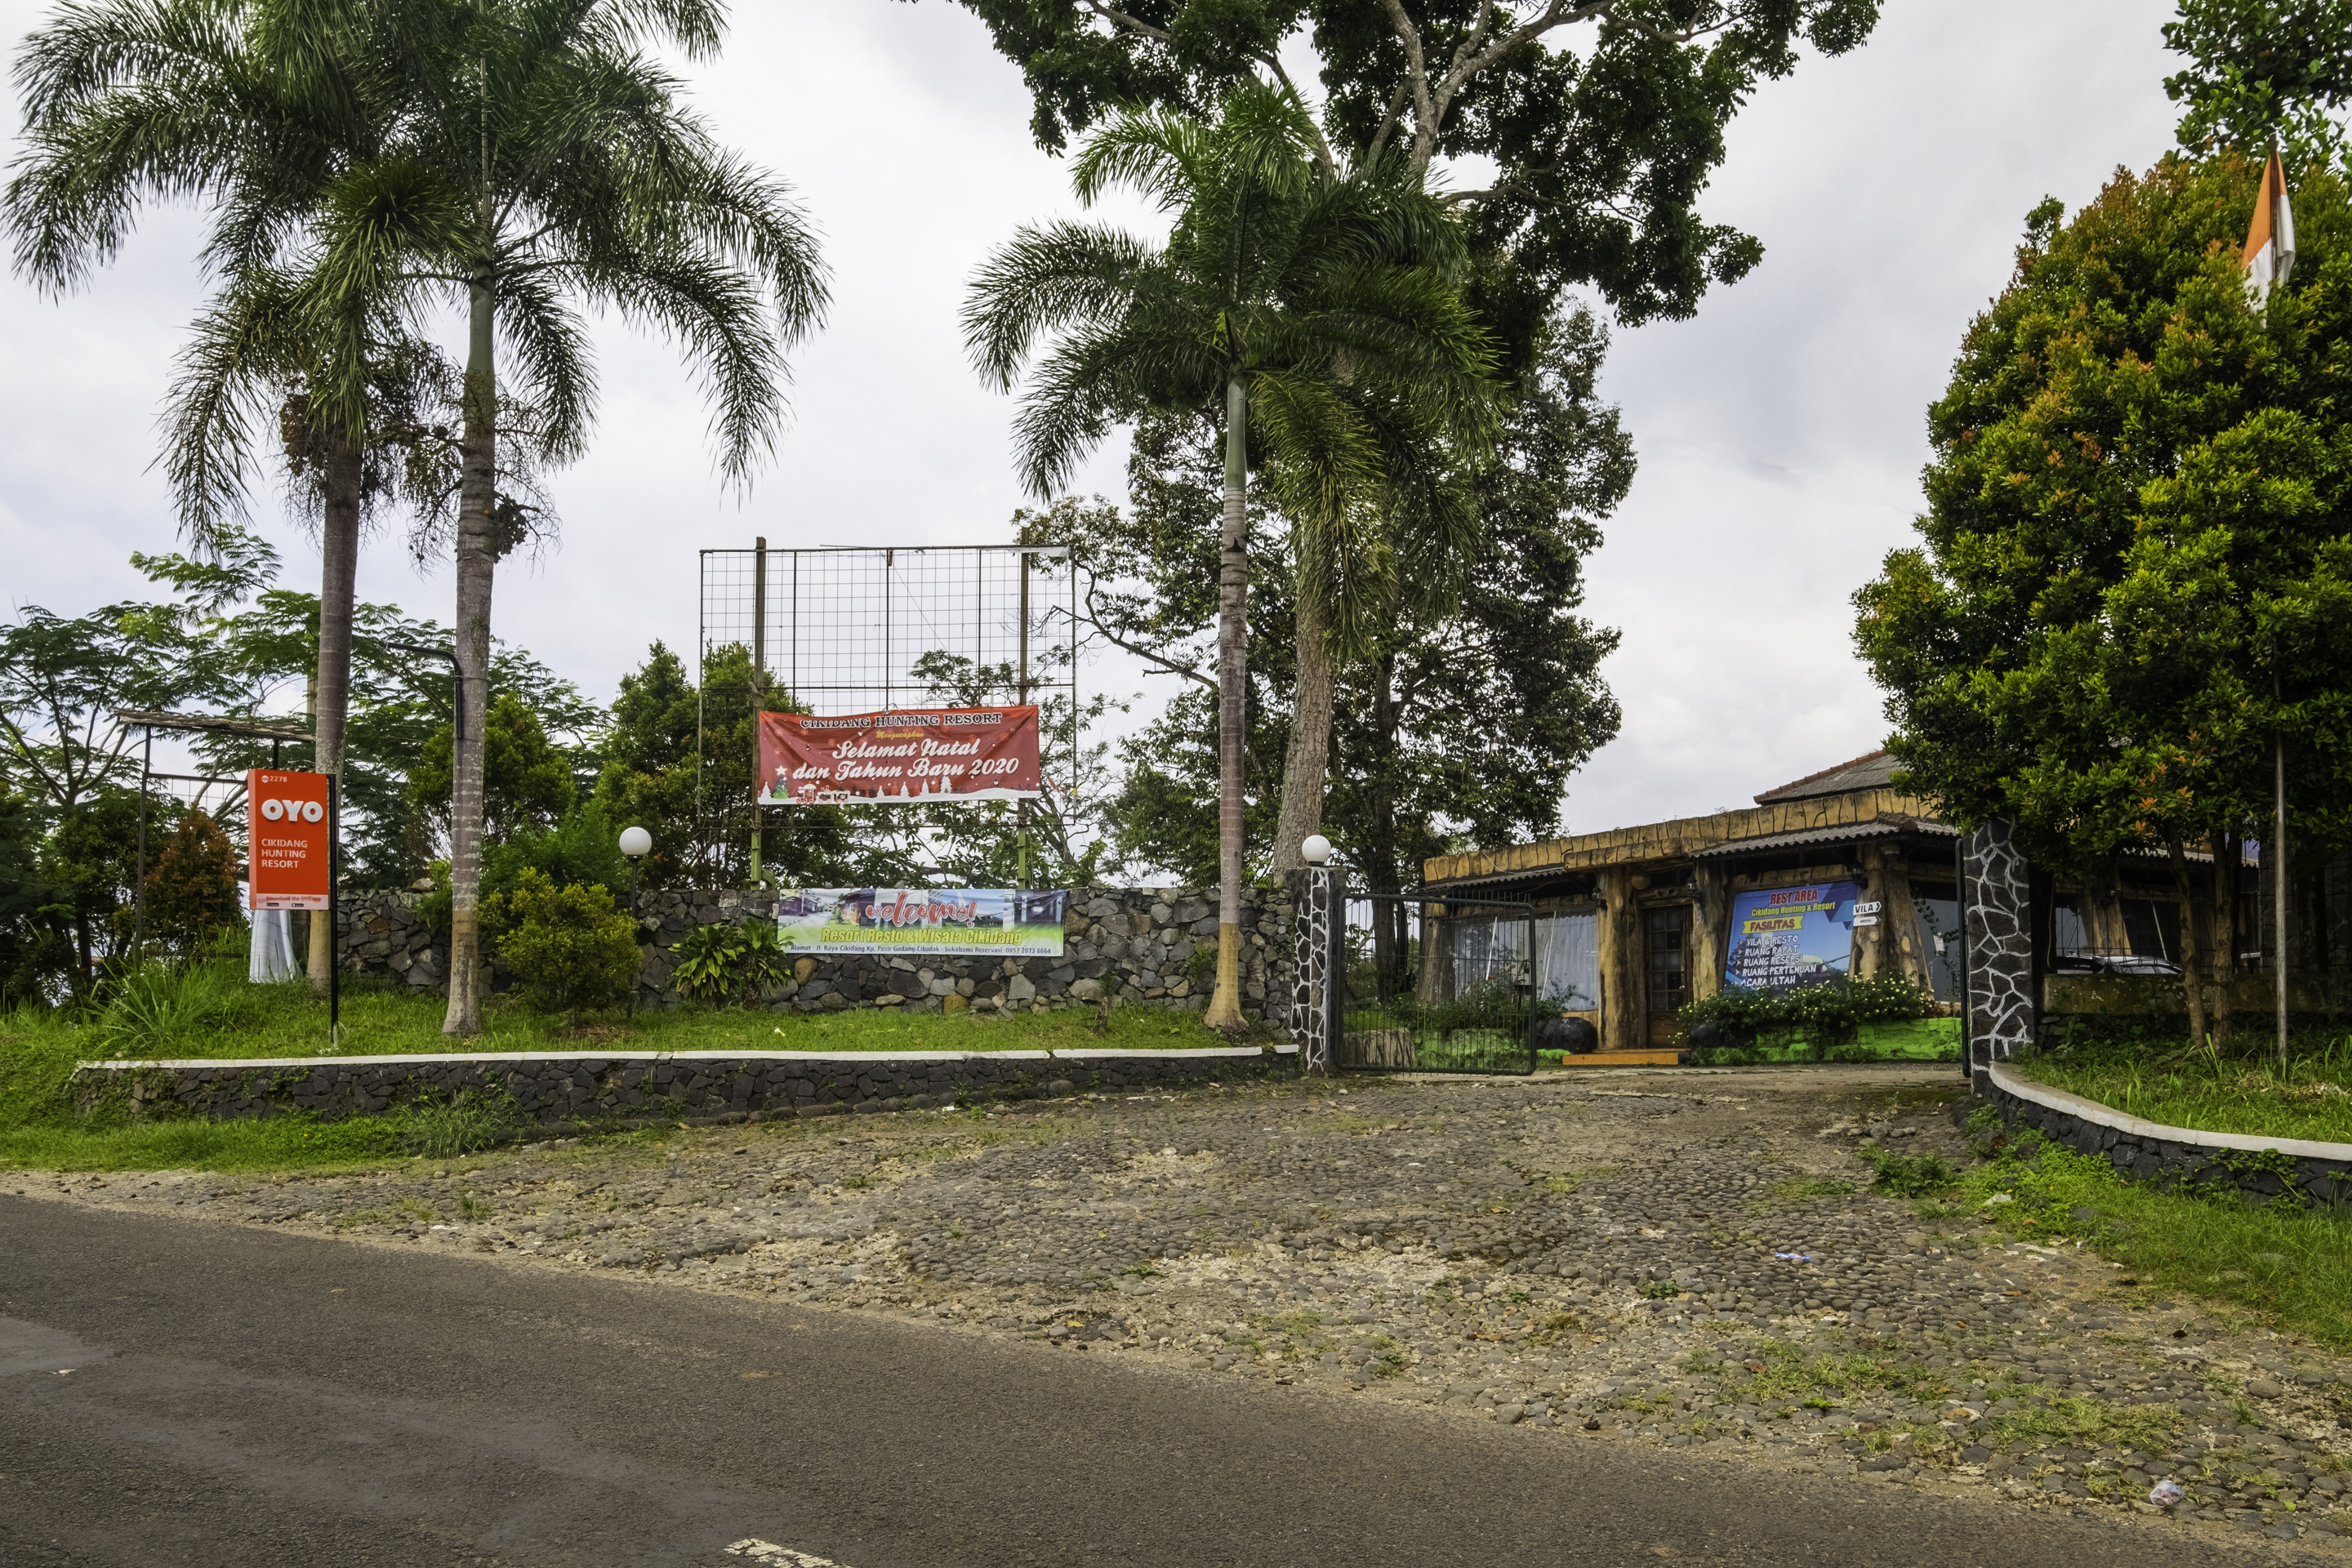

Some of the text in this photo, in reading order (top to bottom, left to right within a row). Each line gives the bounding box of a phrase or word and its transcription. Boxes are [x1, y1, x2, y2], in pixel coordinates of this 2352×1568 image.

[800, 712, 1003, 728] CIKIDANG HUNTING RESORT
[875, 729, 924, 741] Mengucapkan
[832, 737, 981, 759] Selamat Natal
[792, 757, 1019, 781] dan Tahun Baru 2020
[261, 799, 323, 823] OYO
[261, 839, 308, 849] CIKIDANG
[261, 849, 306, 858] HUNTING
[261, 859, 299, 868] RESORT
[1770, 889, 1818, 905] REST AREA
[866, 890, 978, 929] welcome!
[1751, 906, 1780, 917] Cikidang
[1780, 904, 1806, 915] Hunting
[1812, 902, 1836, 911] Resort
[1855, 904, 1873, 913] VILA
[1749, 919, 1795, 932] FASILITAS
[821, 928, 1022, 946] Resort Resto & Wisata Cikidang
[1747, 934, 1799, 947] VILA & RESTO
[840, 945, 865, 953] Cikidang
[1744, 945, 1799, 957] RUANG RAPAT
[1744, 954, 1803, 967] RUANG RESEPSI
[1742, 964, 1817, 978] RUANG PERTEMUAN
[1740, 975, 1796, 987] ACARA ULTAH
